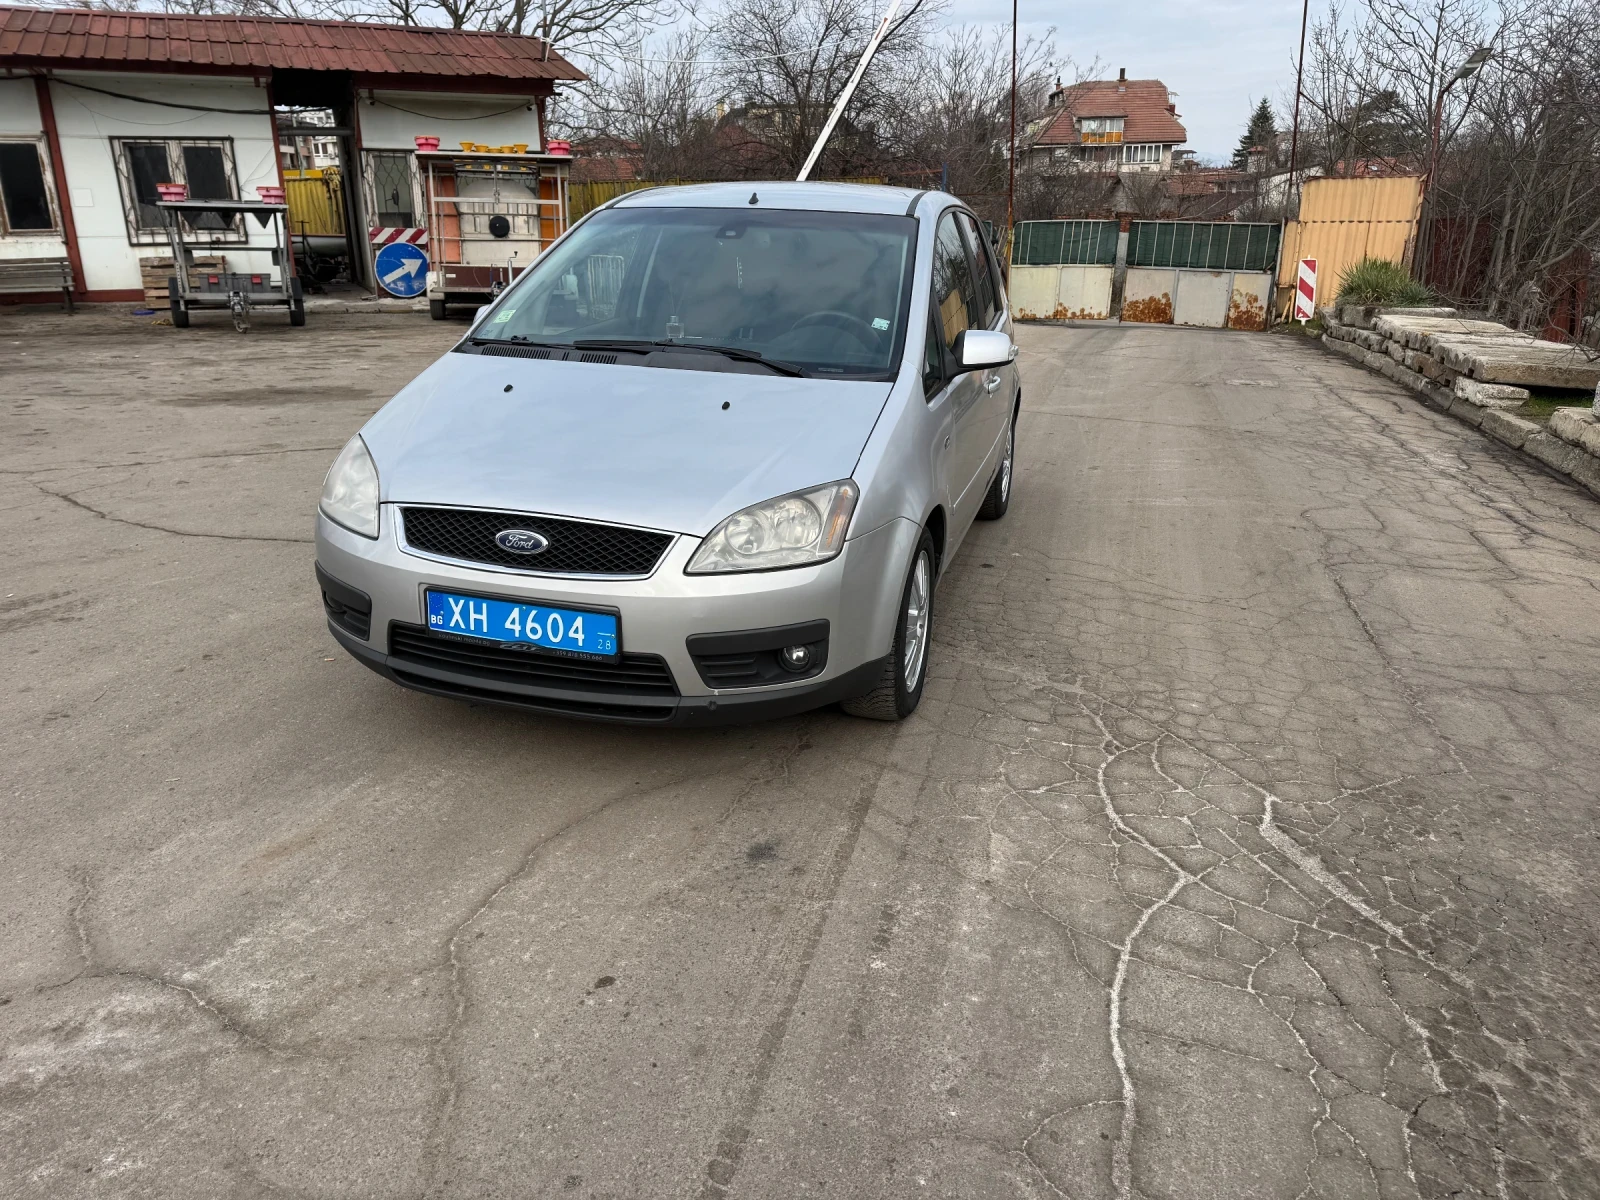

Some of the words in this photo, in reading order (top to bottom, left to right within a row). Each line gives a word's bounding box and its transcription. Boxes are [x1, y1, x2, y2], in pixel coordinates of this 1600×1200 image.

[505, 534, 535, 549] Ford
[430, 614, 444, 625] BG
[504, 607, 585, 646] 4604
[597, 639, 612, 650] 28
